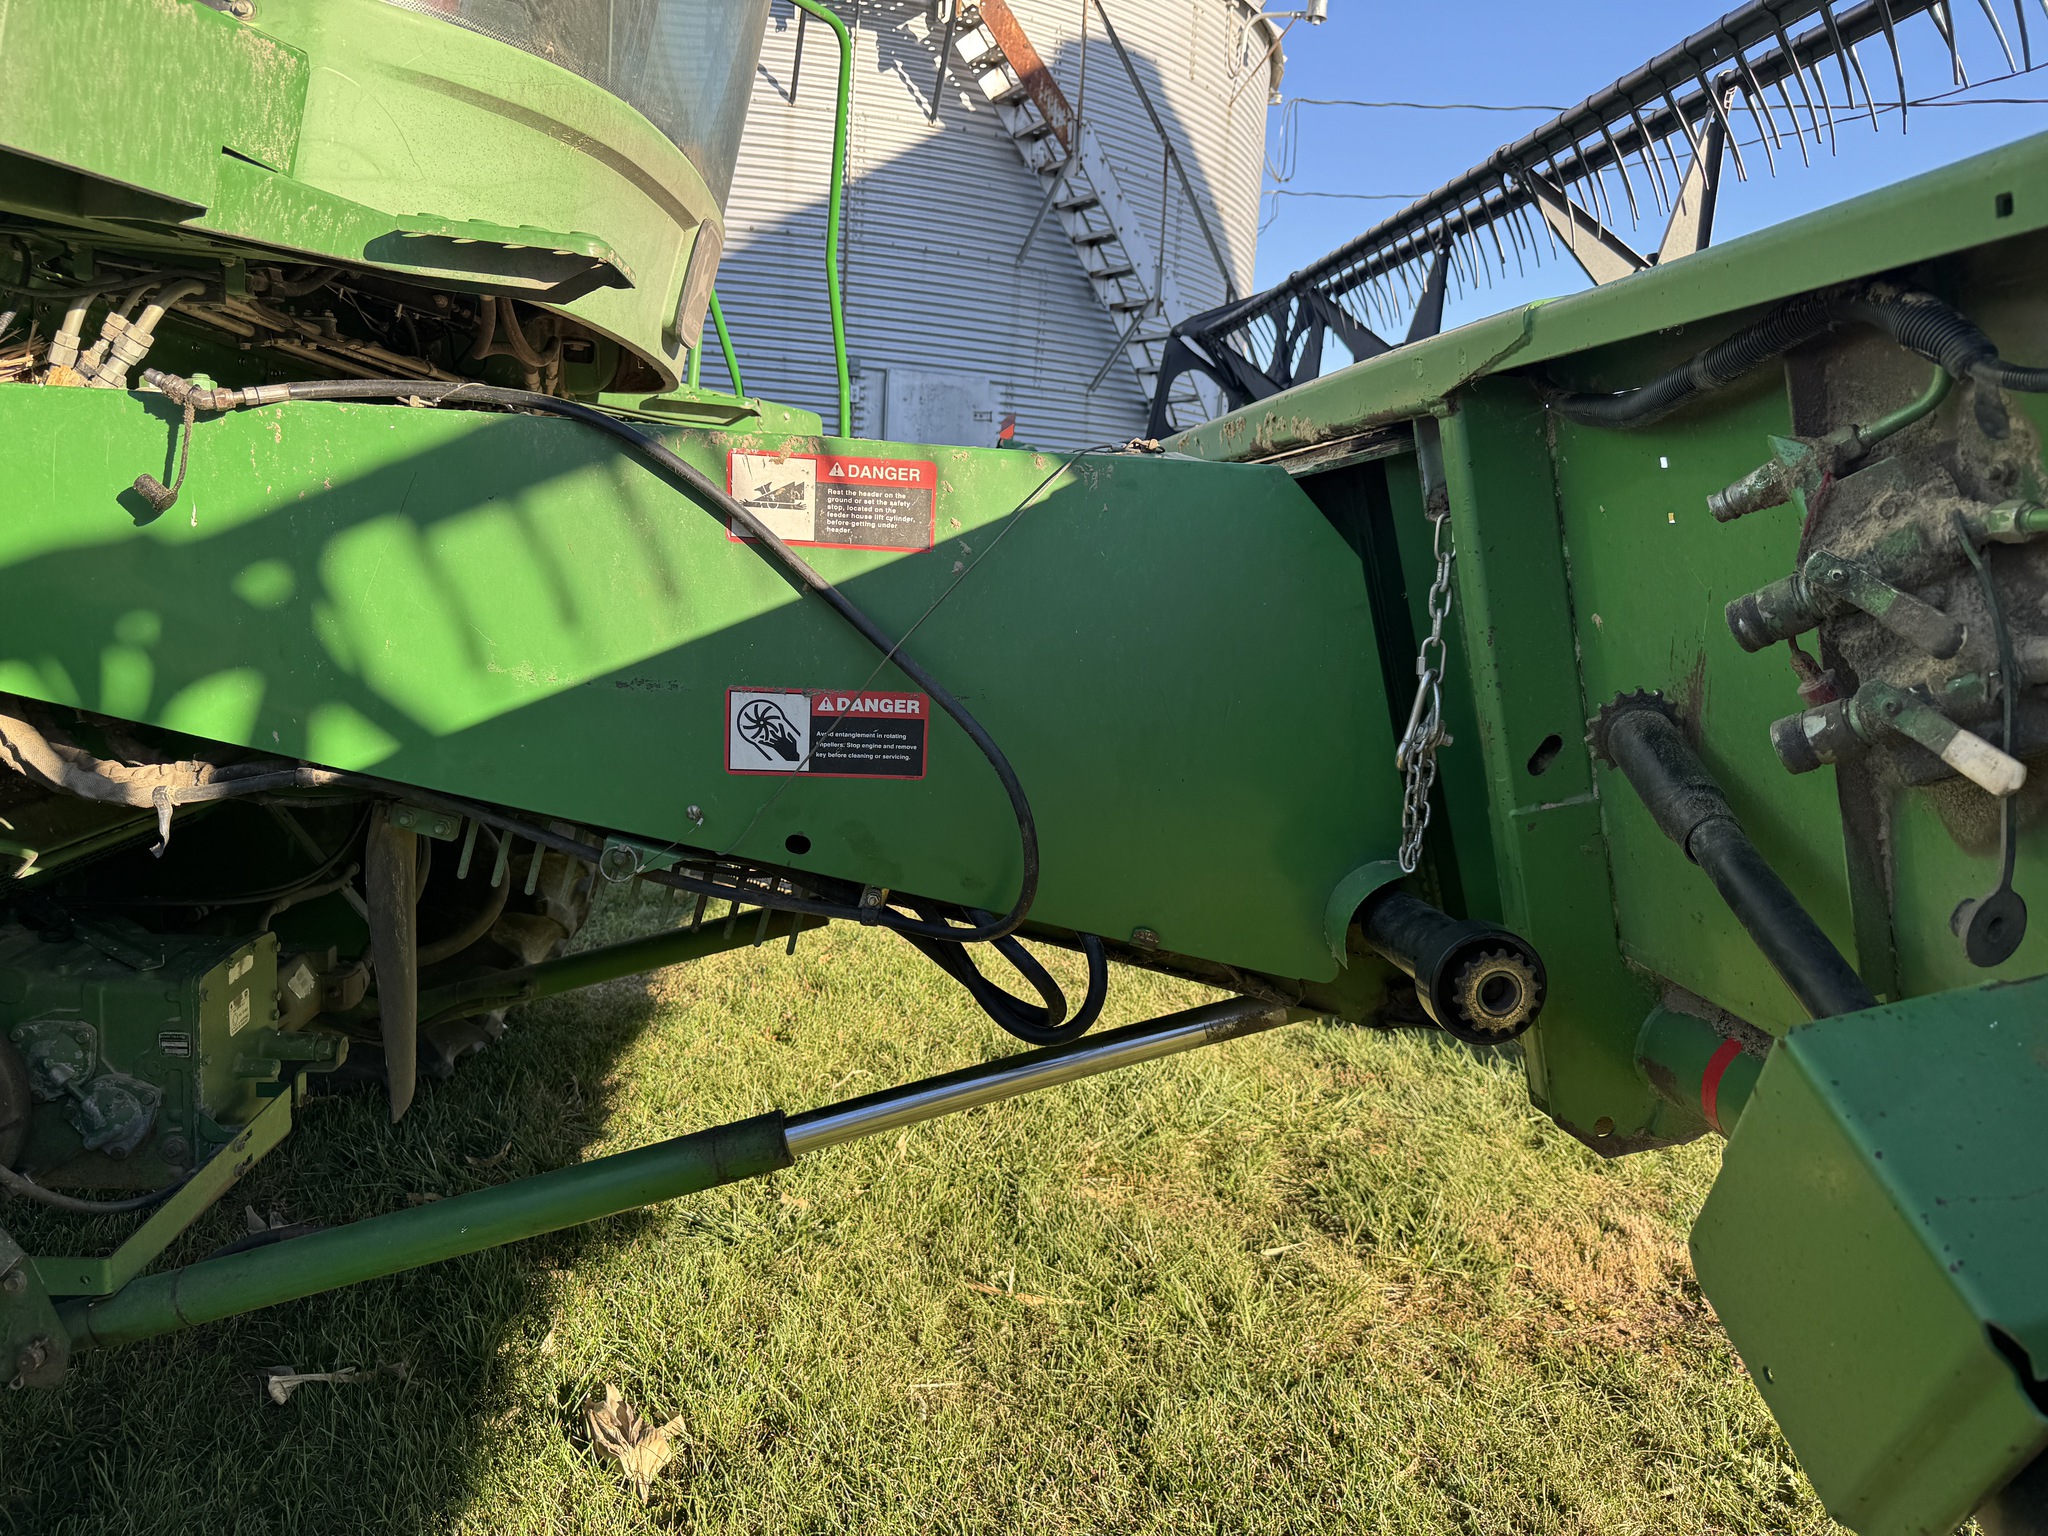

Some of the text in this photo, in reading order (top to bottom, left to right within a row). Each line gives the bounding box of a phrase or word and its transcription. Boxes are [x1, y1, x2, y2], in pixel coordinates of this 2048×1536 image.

[848, 464, 920, 482] DANGER
[890, 500, 910, 508] safety
[886, 515, 915, 523] cylinder,
[837, 698, 920, 714] DANGER
